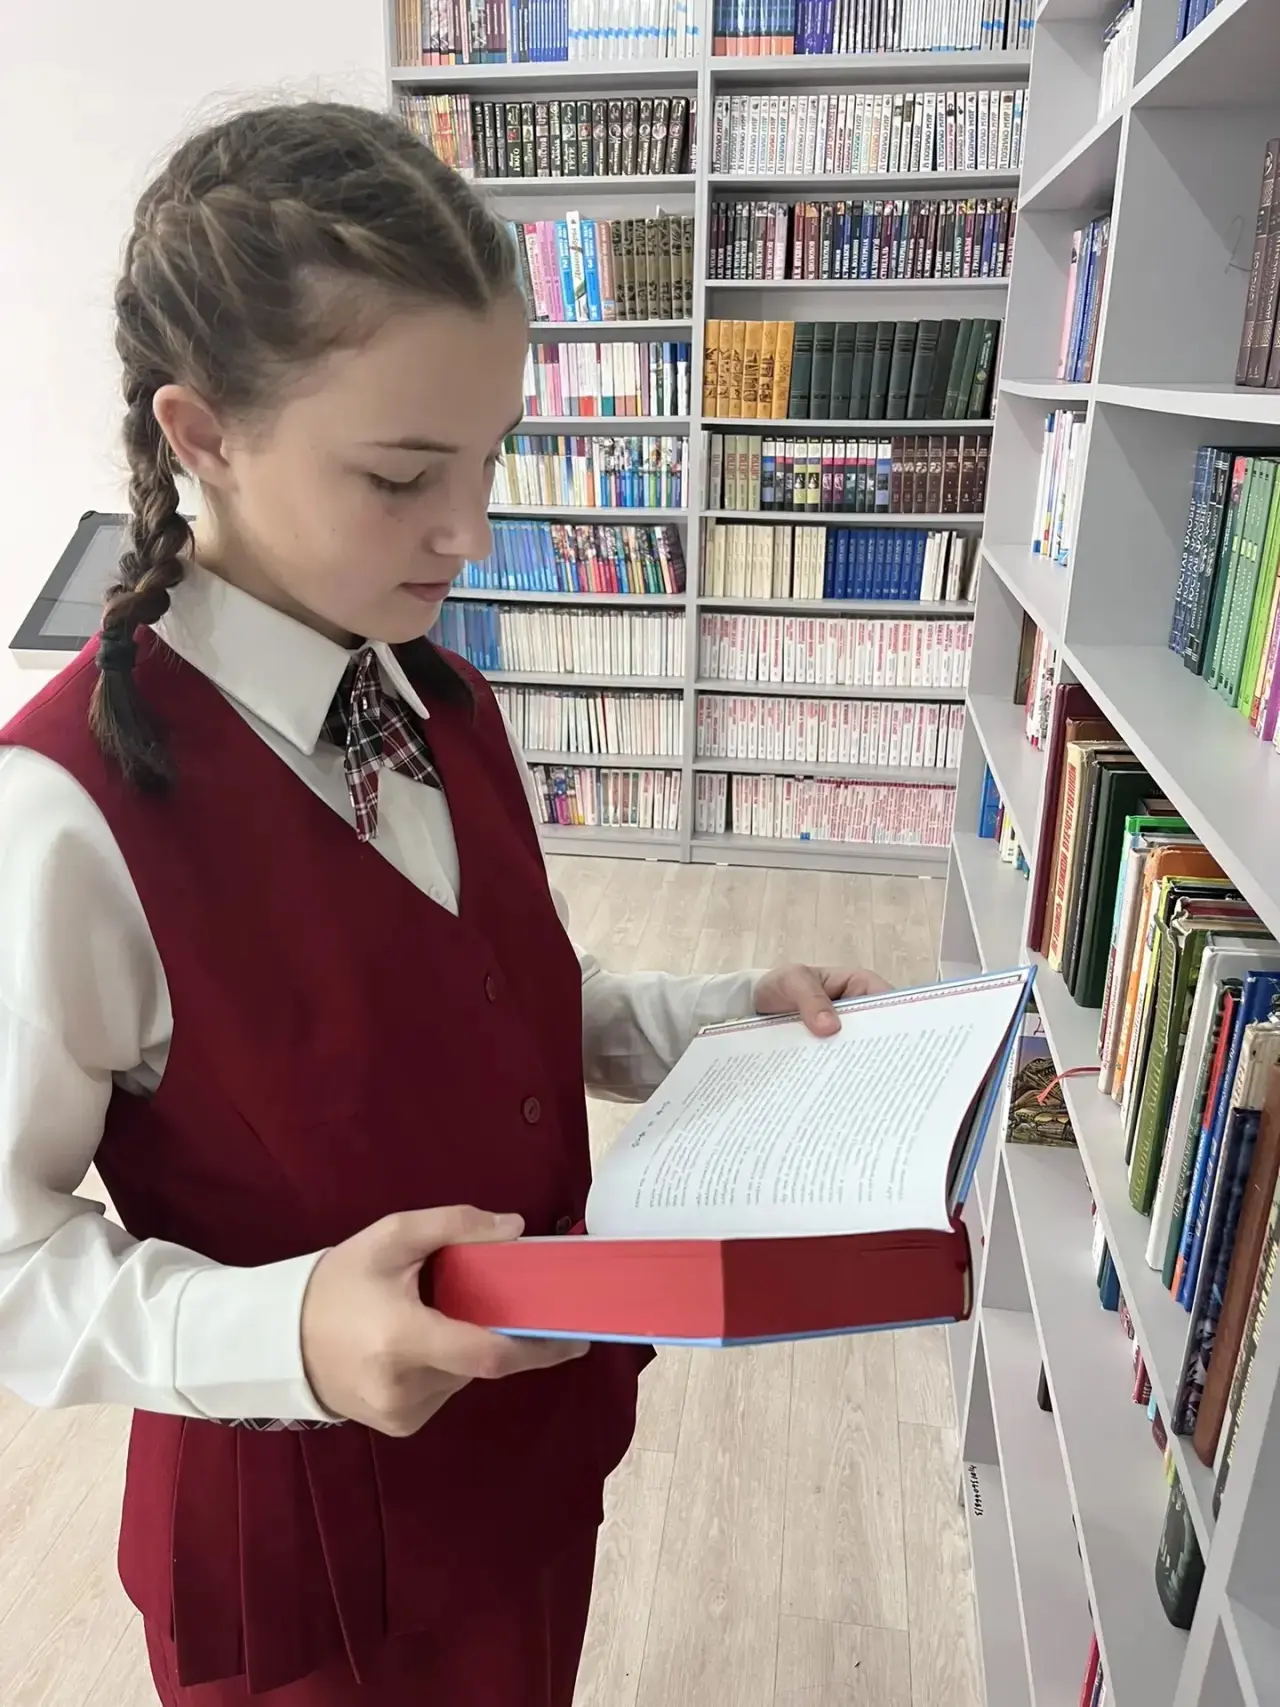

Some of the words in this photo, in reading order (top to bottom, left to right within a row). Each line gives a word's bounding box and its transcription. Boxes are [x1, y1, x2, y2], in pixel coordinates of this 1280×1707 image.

[1000, 130, 1009, 162] ПОЗНАЮ
[1247, 251, 1261, 308] ТОЛСТОЙ
[1184, 498, 1196, 548] ФЛОБЕР
[1195, 501, 1207, 552] ФЛОБЕР
[1060, 762, 1077, 852] ОТЕЧЕСТВЕННОЙ
[1056, 853, 1068, 901] ВЕЛИКОЙ
[1051, 903, 1063, 955] ЛЕТОПИСЬ
